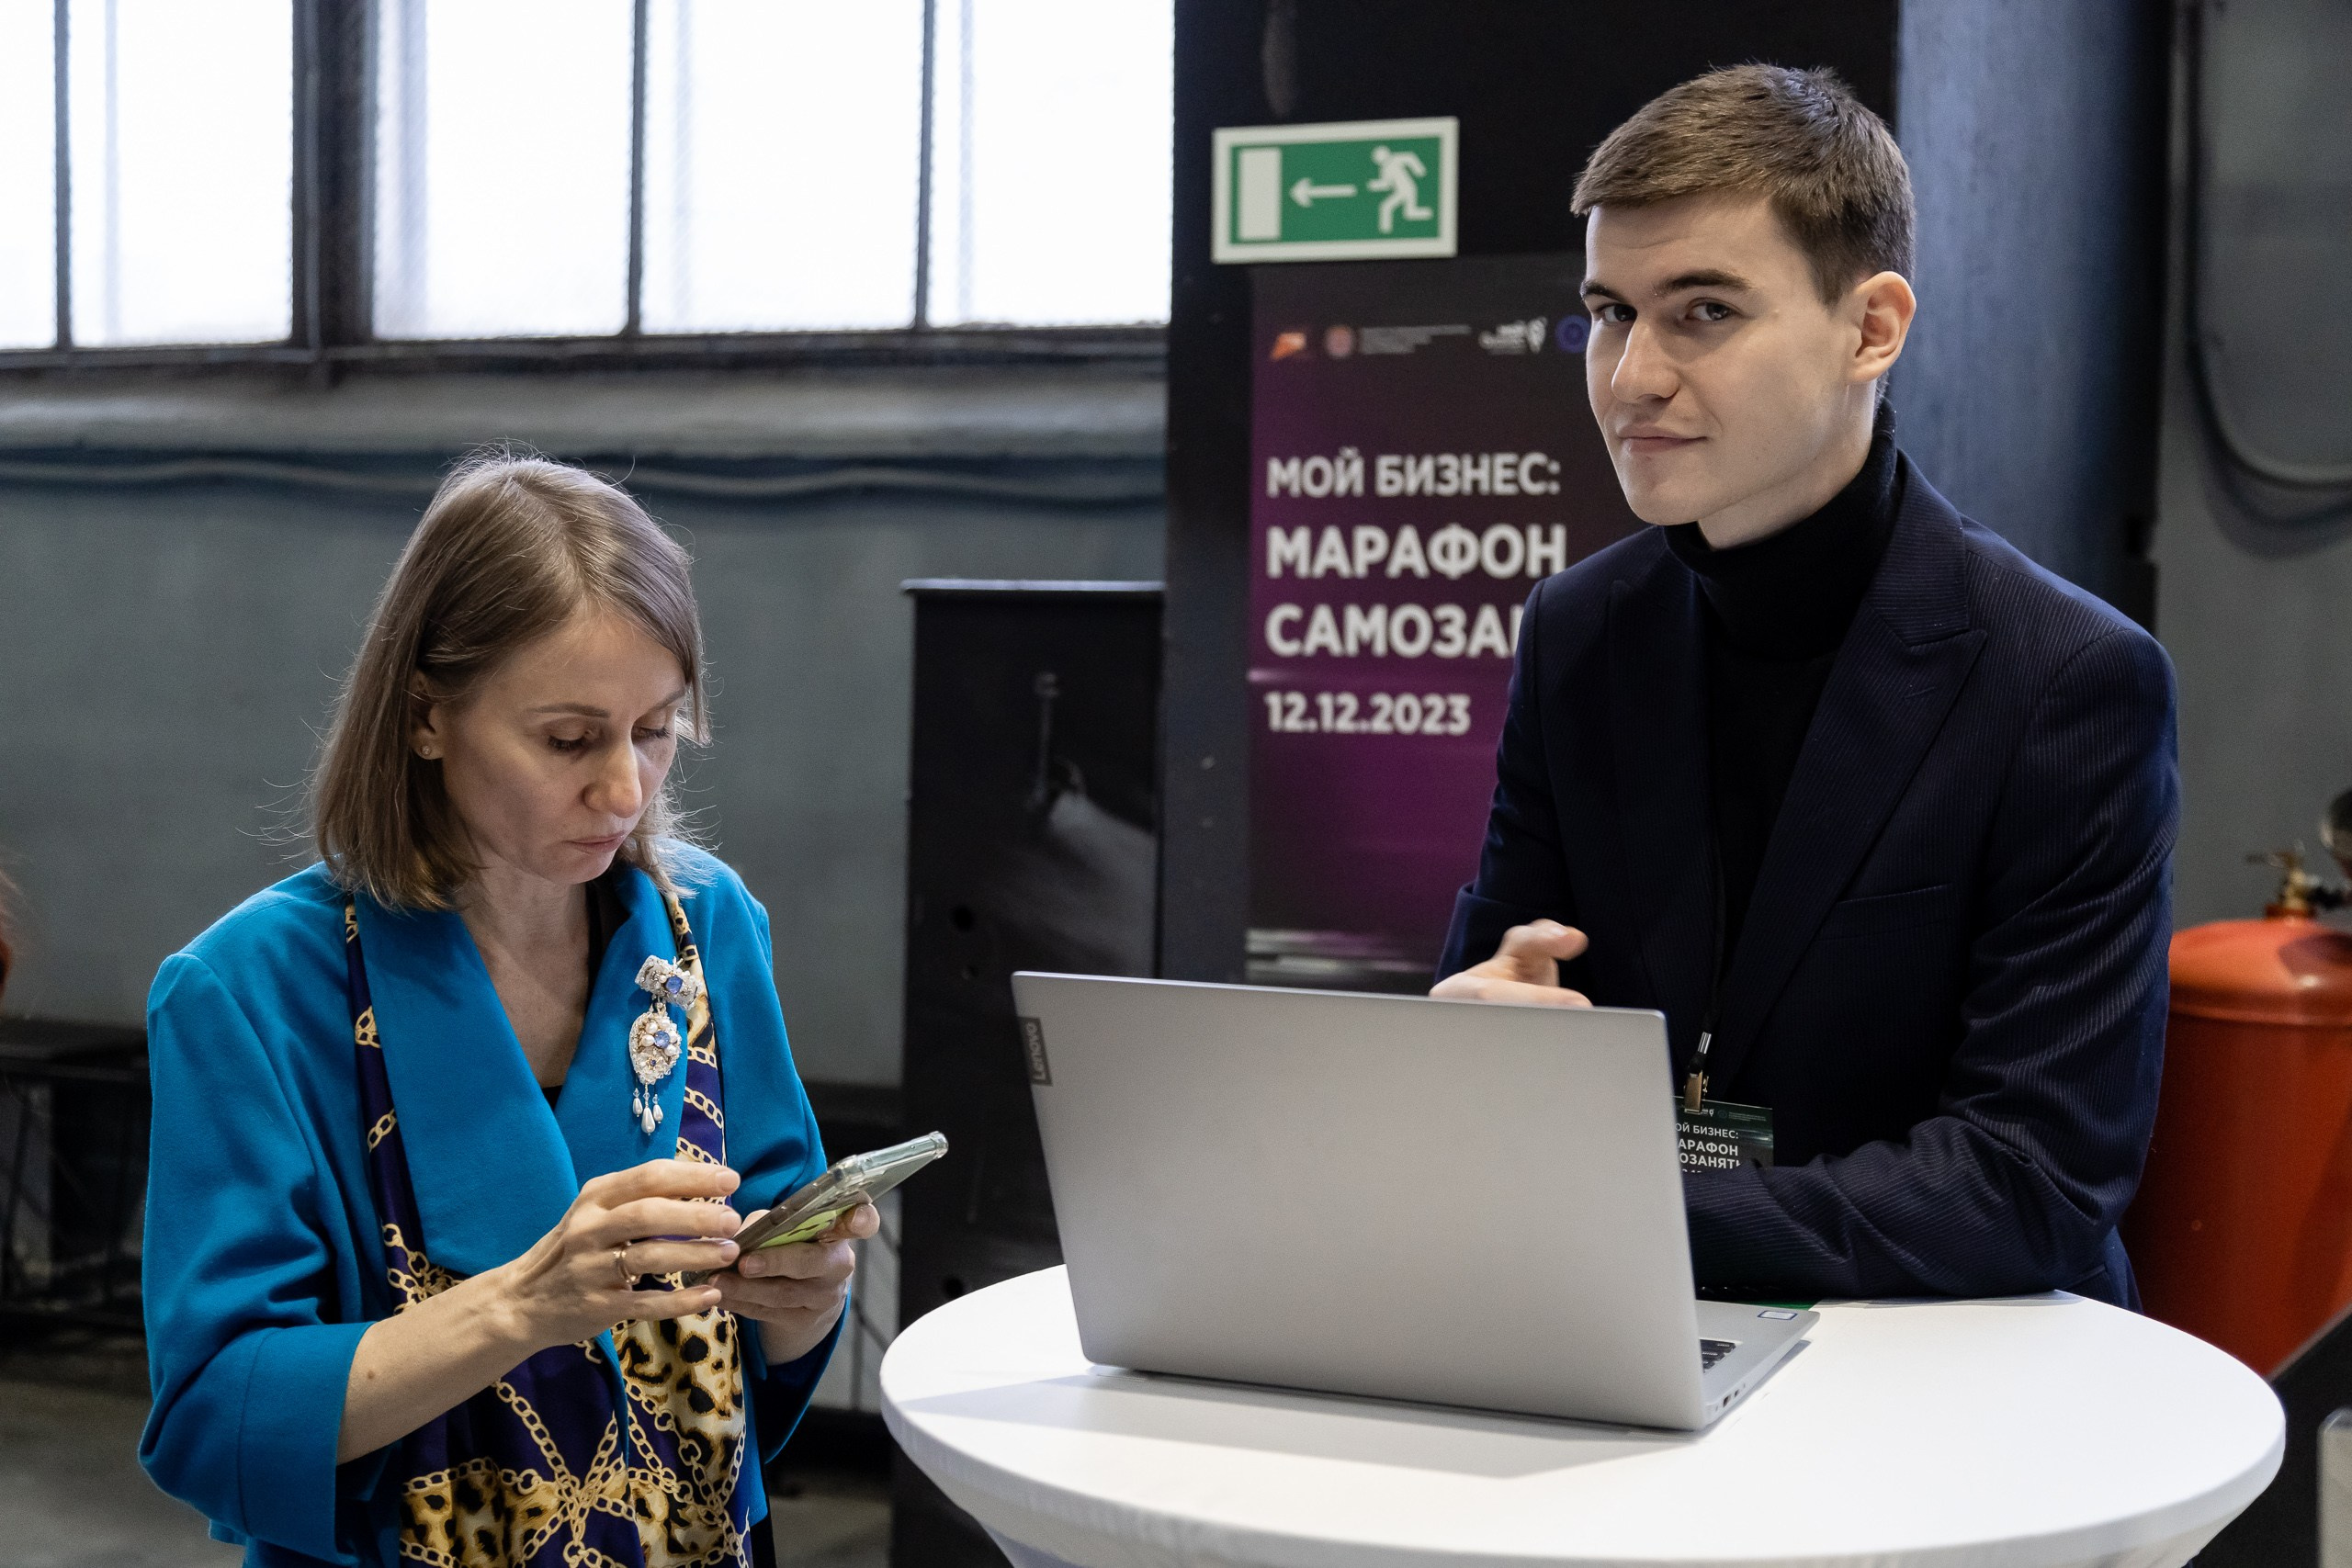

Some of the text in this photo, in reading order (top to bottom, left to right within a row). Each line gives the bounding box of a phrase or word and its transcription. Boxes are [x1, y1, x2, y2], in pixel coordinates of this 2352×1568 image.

[1266, 446, 1560, 497] МОЙ БИЗНЕС:
[1266, 524, 1566, 580] МАРАФОН
[1263, 691, 1472, 735] 12.12.2023
[1675, 1122, 1739, 1139] ОЙ БИЗНЕС:
[1678, 1138, 1738, 1156] АРАФОН
[1679, 1153, 1741, 1169] ОЗАНЯТ
